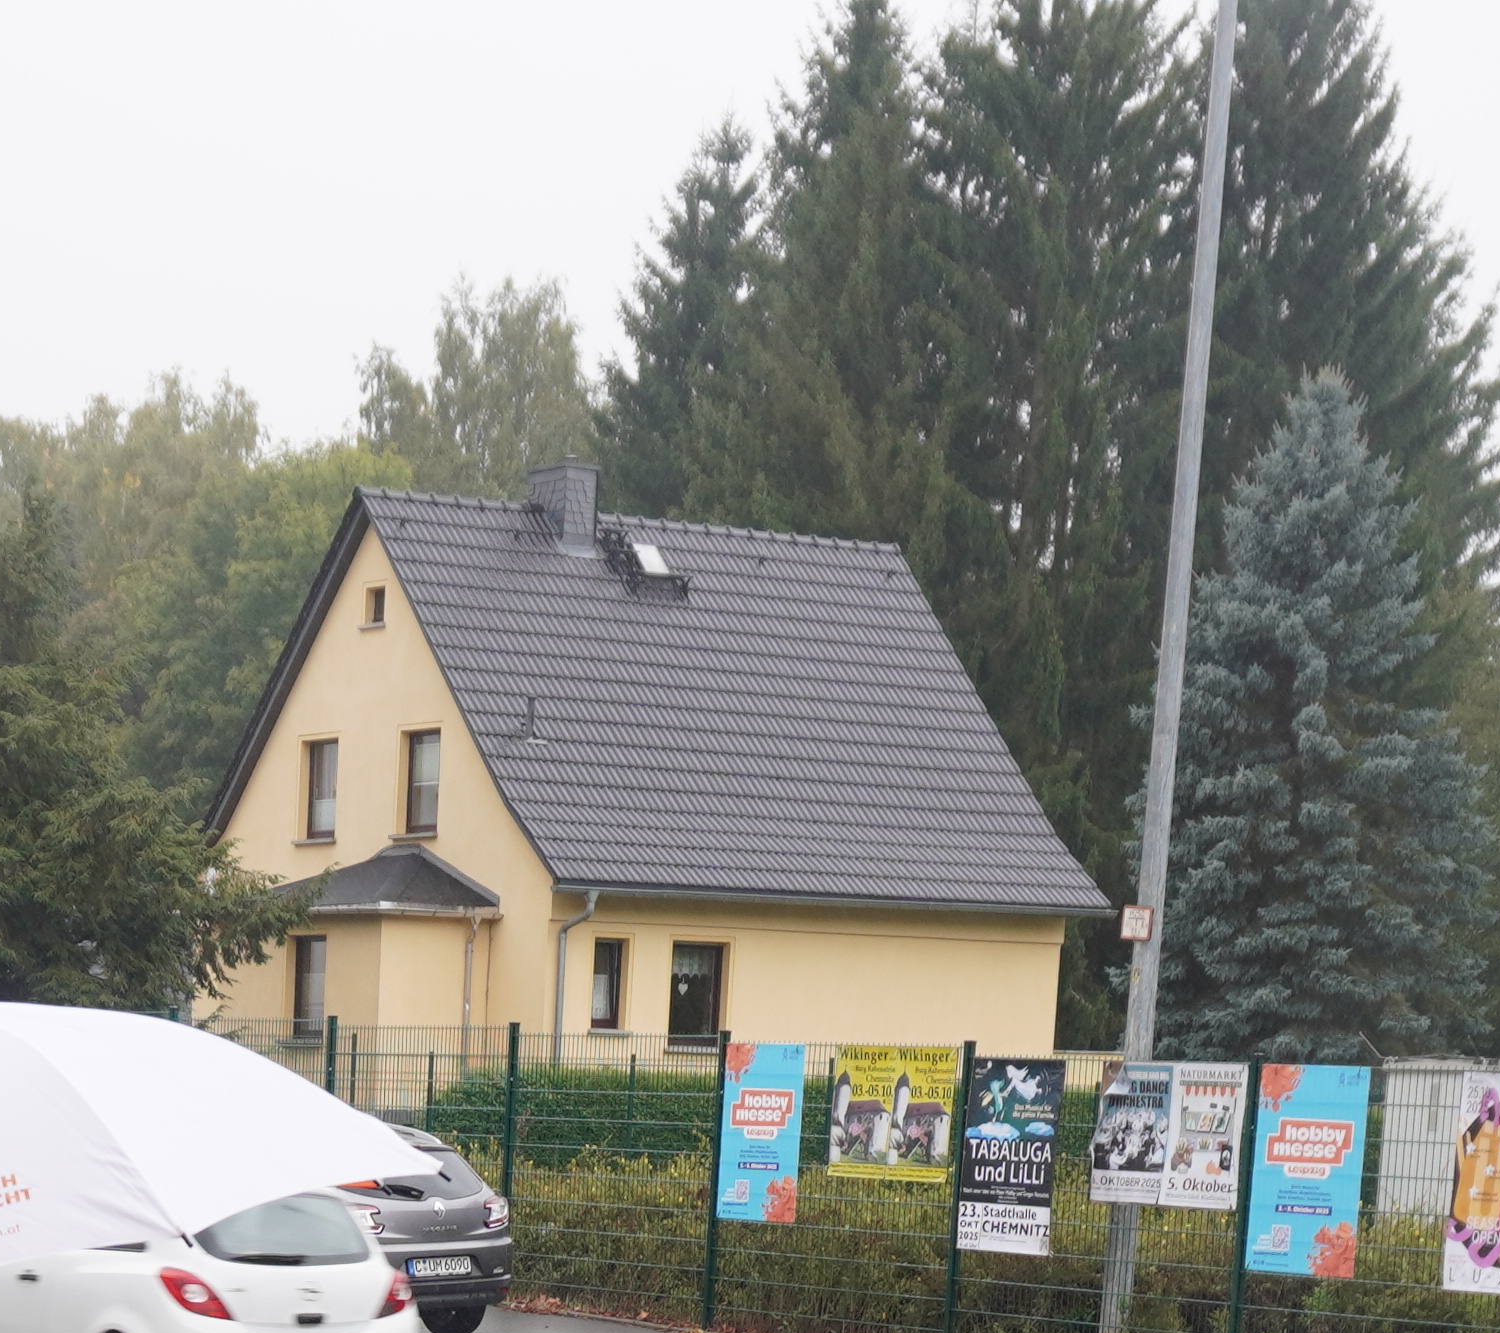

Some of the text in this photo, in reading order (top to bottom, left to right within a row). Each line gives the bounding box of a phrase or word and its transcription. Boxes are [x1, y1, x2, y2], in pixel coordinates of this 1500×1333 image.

[840, 1047, 889, 1065] Wikinger
[899, 1048, 950, 1067] Wikinger
[1180, 1069, 1243, 1080] NATURMARKT
[1140, 1081, 1170, 1095] DANCE
[744, 1093, 790, 1112] hobby
[735, 1108, 782, 1122] messe
[1285, 1124, 1347, 1147] hobby
[969, 1138, 1052, 1163] TABALUGA
[1272, 1141, 1337, 1159] messe
[974, 1161, 1006, 1183] und
[1287, 1165, 1326, 1177] Leipzig
[1100, 1175, 1141, 1187] OKTOBER
[1167, 1176, 1234, 1193] 5. Oktober
[960, 1203, 1037, 1221] 23. Stadthalle
[959, 1231, 979, 1241] 2025
[960, 1219, 1050, 1238] OKT CHEMNITZ
[1471, 1230, 1500, 1245] OPEN
